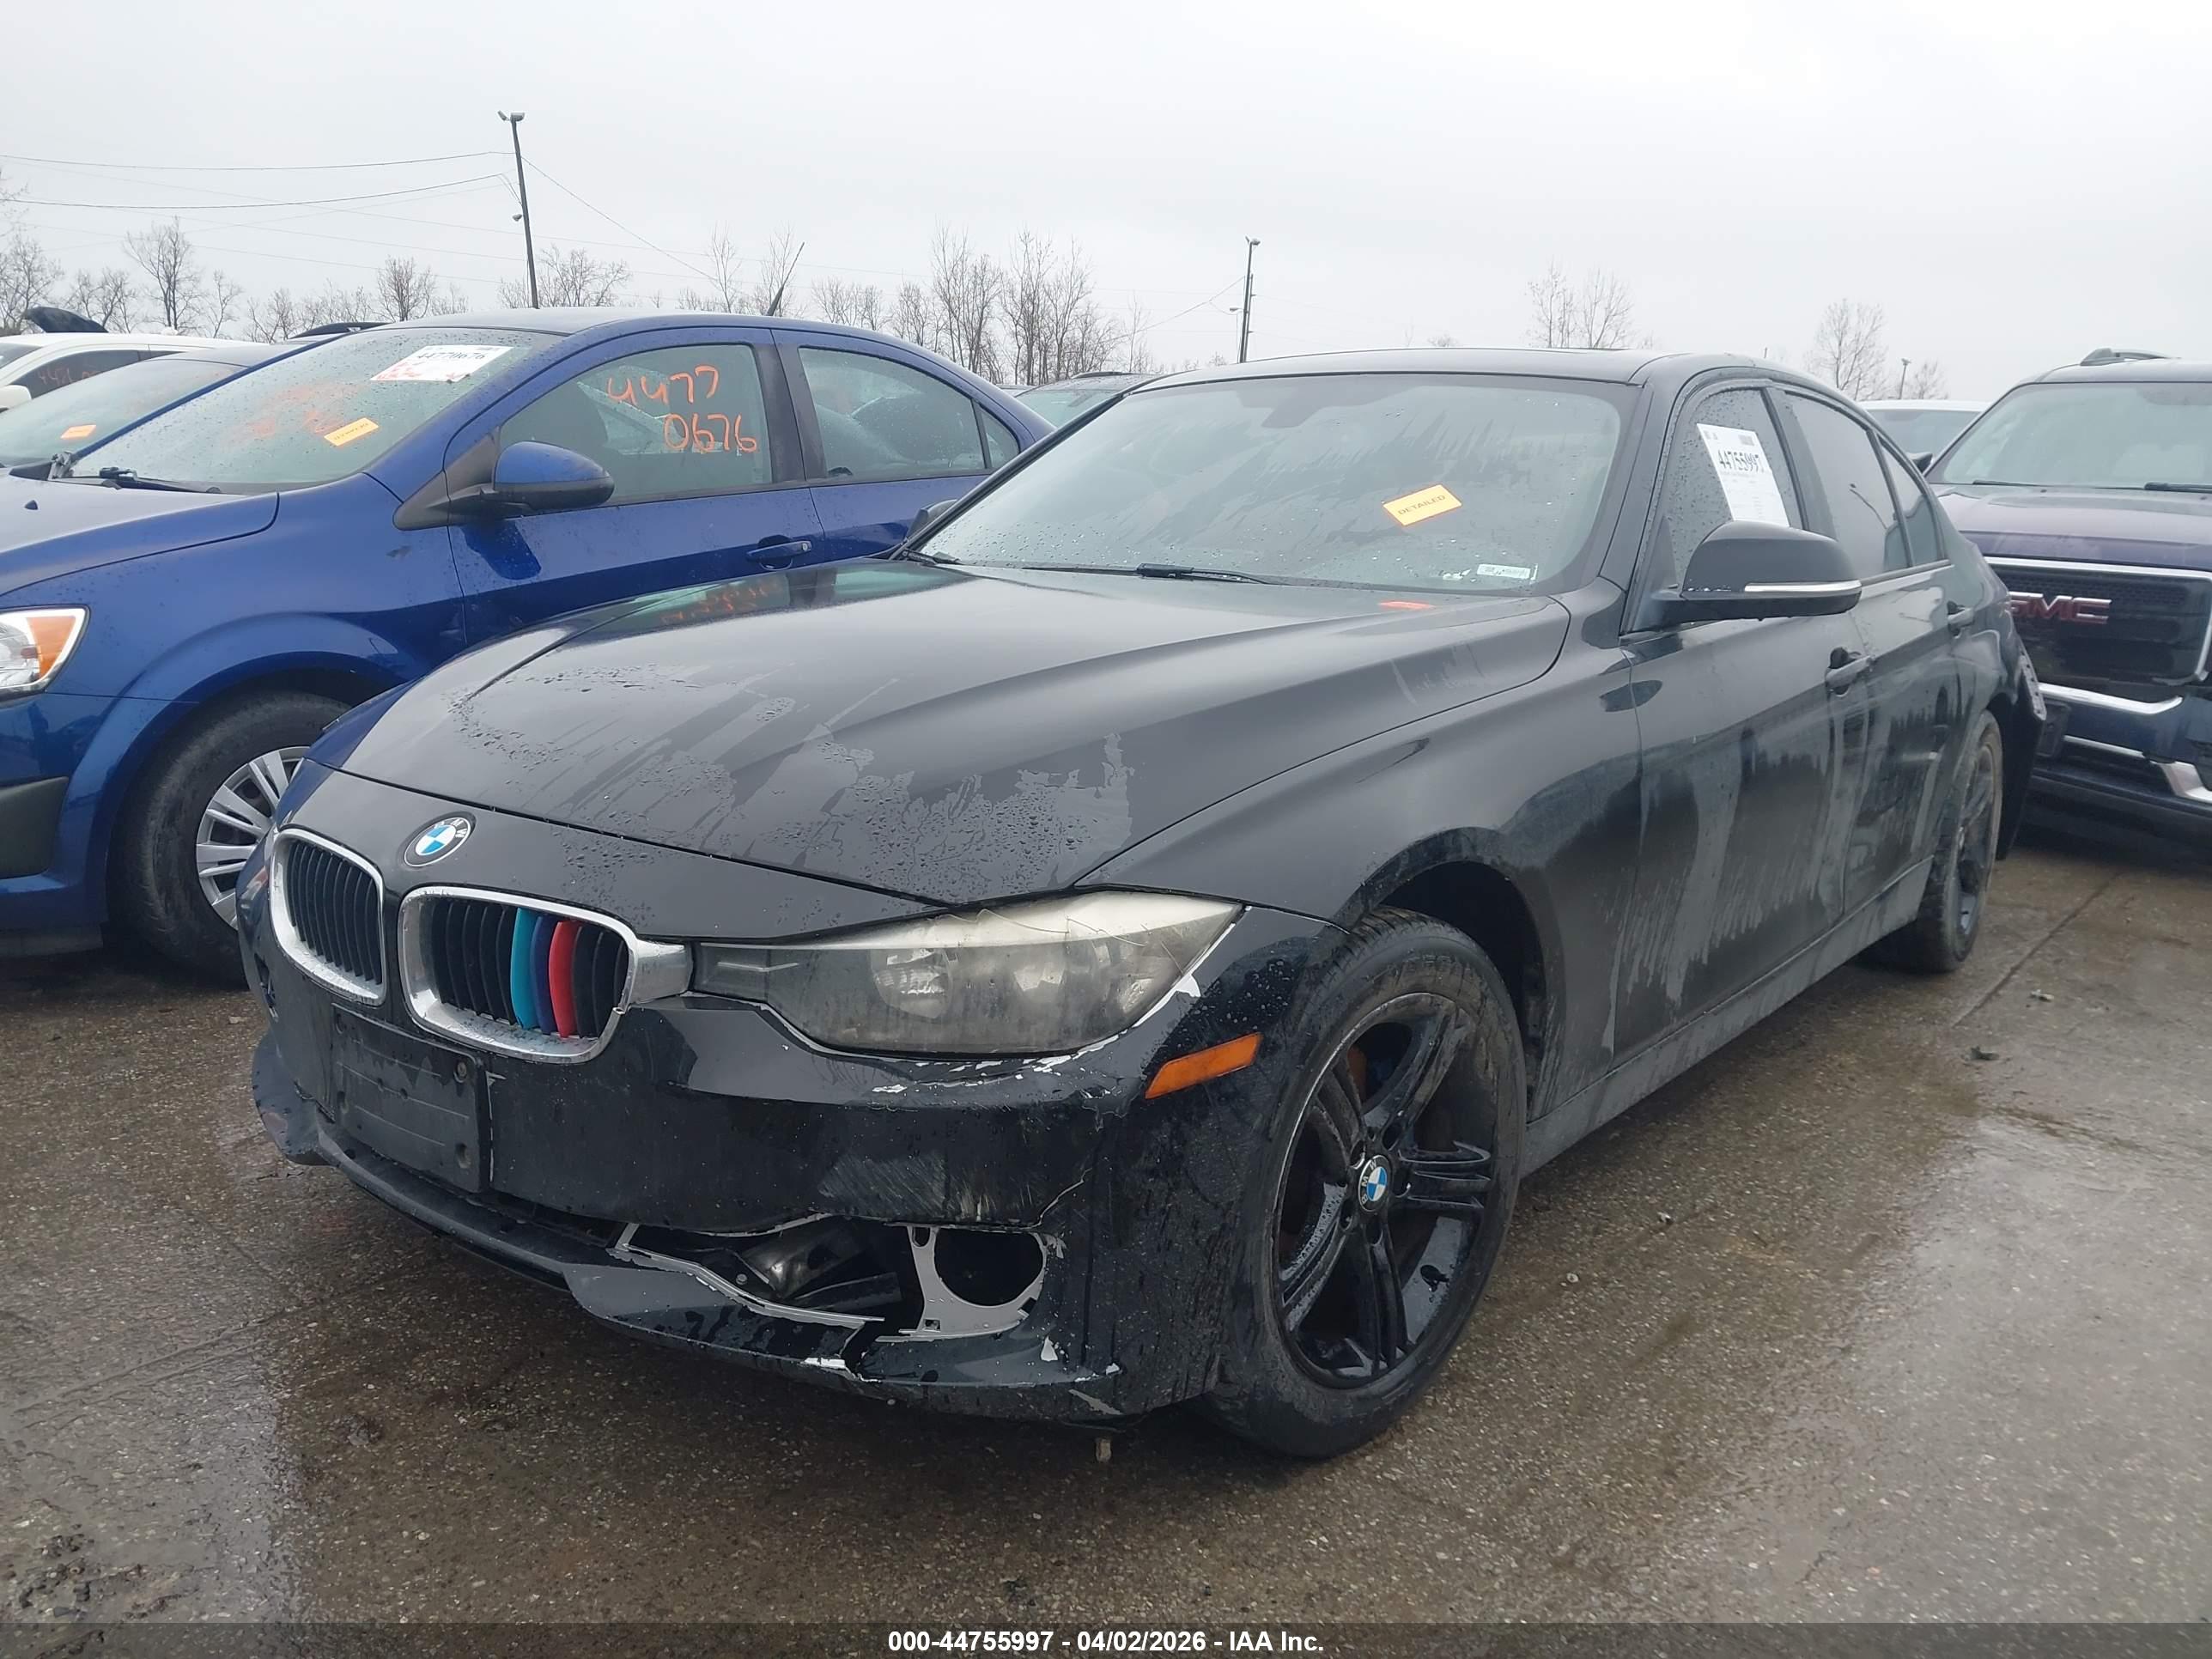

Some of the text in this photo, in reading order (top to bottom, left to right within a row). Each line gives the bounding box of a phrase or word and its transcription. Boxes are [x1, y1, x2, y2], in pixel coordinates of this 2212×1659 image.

[606, 364, 720, 405] 4477
[664, 412, 757, 453] 0676
[1717, 449, 1765, 474] 44755997
[1397, 494, 1447, 516] DETAILED
